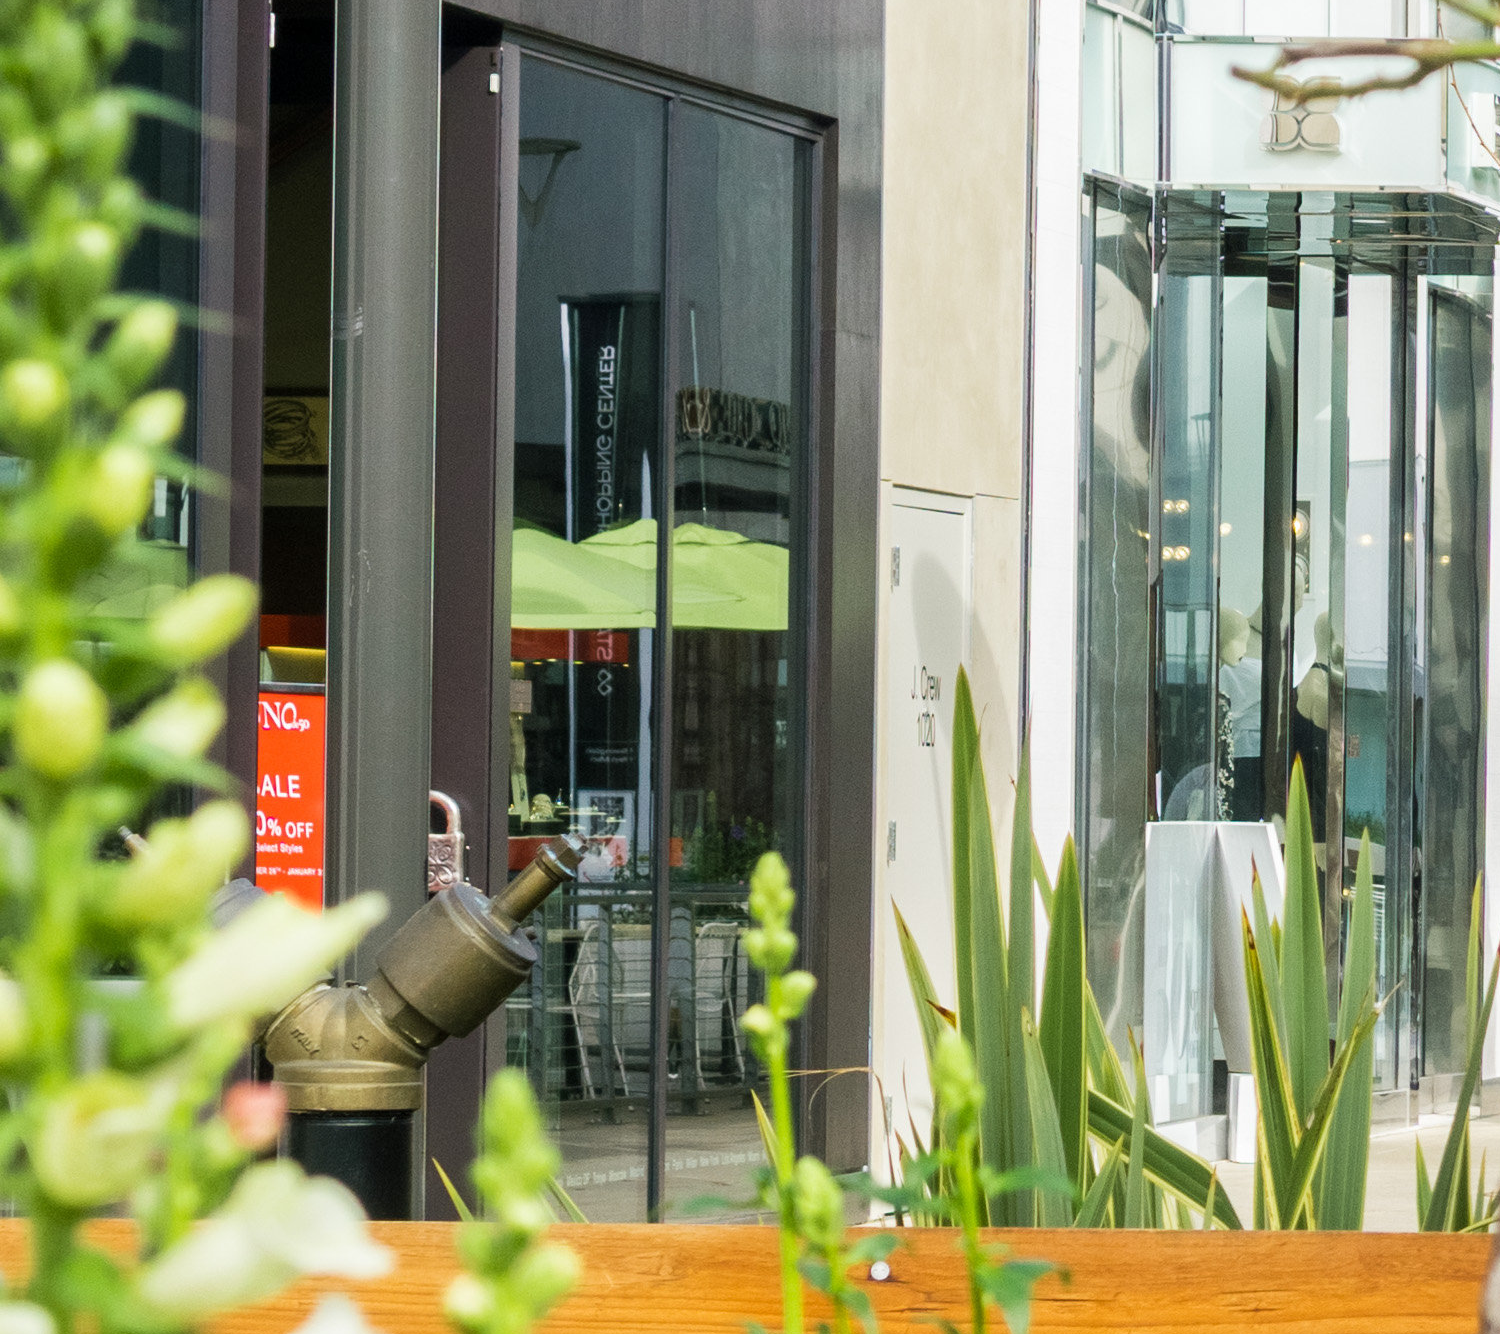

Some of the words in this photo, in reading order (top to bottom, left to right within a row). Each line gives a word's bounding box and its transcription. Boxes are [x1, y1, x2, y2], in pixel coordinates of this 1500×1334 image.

[920, 665, 942, 701] Crew
[258, 701, 297, 730] NO
[257, 774, 301, 798] ALE
[256, 810, 281, 837] 0%
[285, 822, 313, 839] OFF
